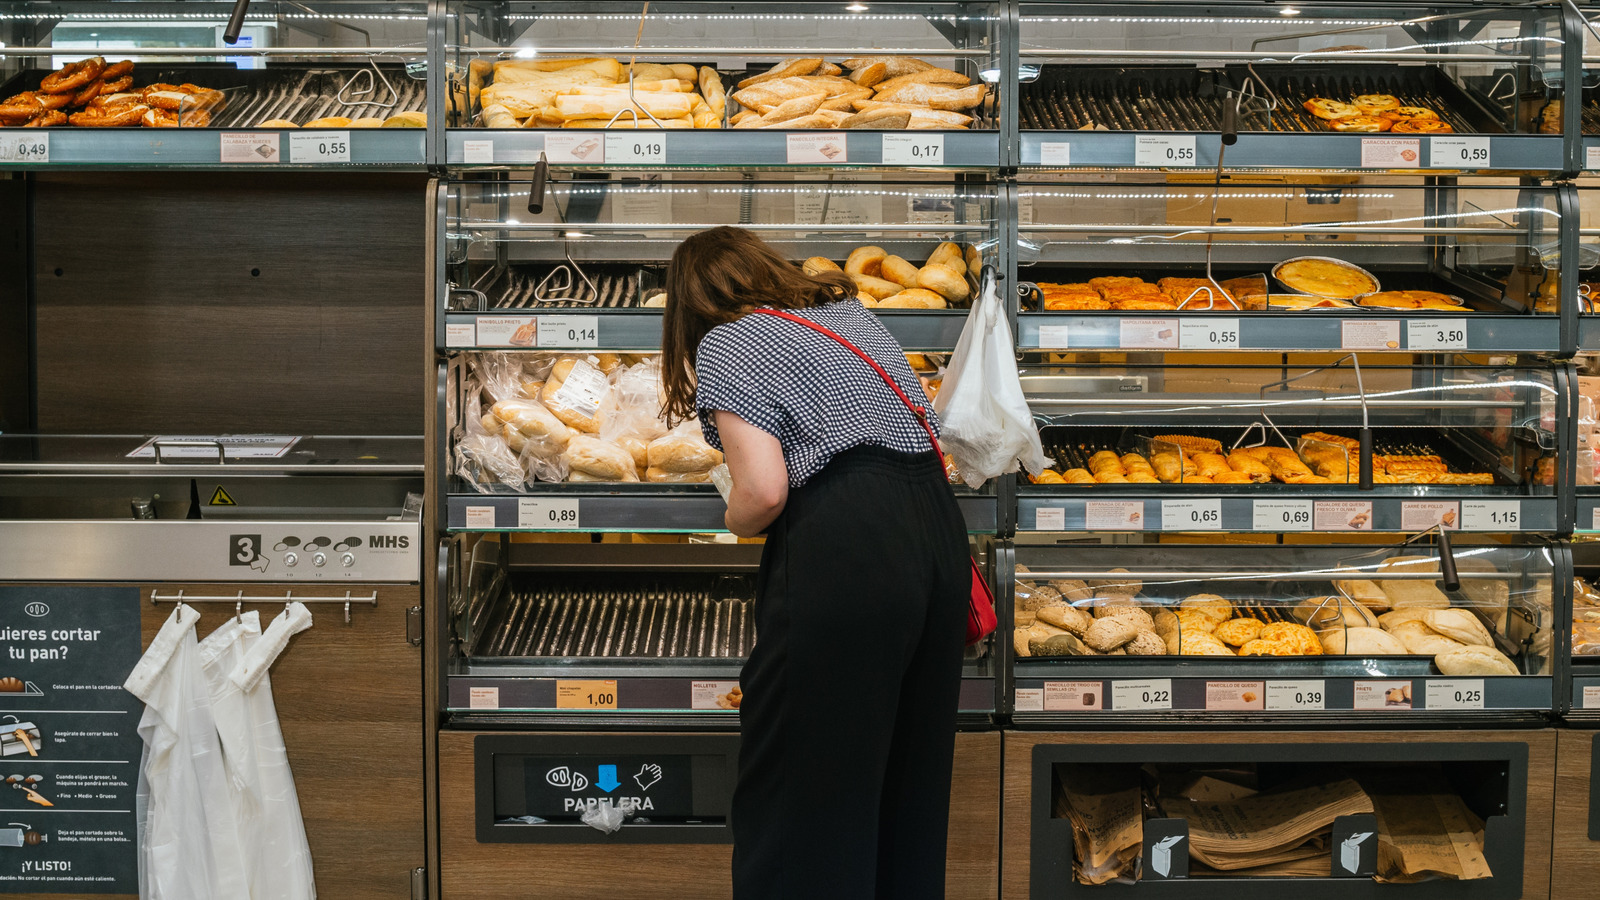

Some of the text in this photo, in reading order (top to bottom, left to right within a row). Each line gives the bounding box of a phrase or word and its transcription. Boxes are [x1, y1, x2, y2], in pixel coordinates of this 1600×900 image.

[18, 144, 46, 156] 0,49
[318, 143, 346, 156] 0,55
[633, 144, 661, 157] 0,19
[912, 145, 939, 158] 0,17
[1166, 148, 1193, 161] 0,55
[1461, 148, 1488, 161] 0,59
[568, 329, 595, 342] 0,14
[1209, 332, 1236, 345] 0,55
[1437, 331, 1463, 343] 3,50
[549, 510, 576, 522] 0,89
[1191, 510, 1217, 523] 0,65
[1283, 512, 1309, 524] 0,69
[1490, 512, 1517, 524] 1,15
[369, 535, 409, 548] MHS
[236, 537, 254, 562] 3
[51, 628, 101, 640] cortar
[9, 646, 68, 662] tu pan?
[587, 694, 613, 706] 1,00
[1142, 691, 1169, 704] 0,22
[1296, 692, 1321, 705] 0,39
[1455, 691, 1480, 703] 0,25
[22, 861, 71, 872] ¡Y LISTO!
